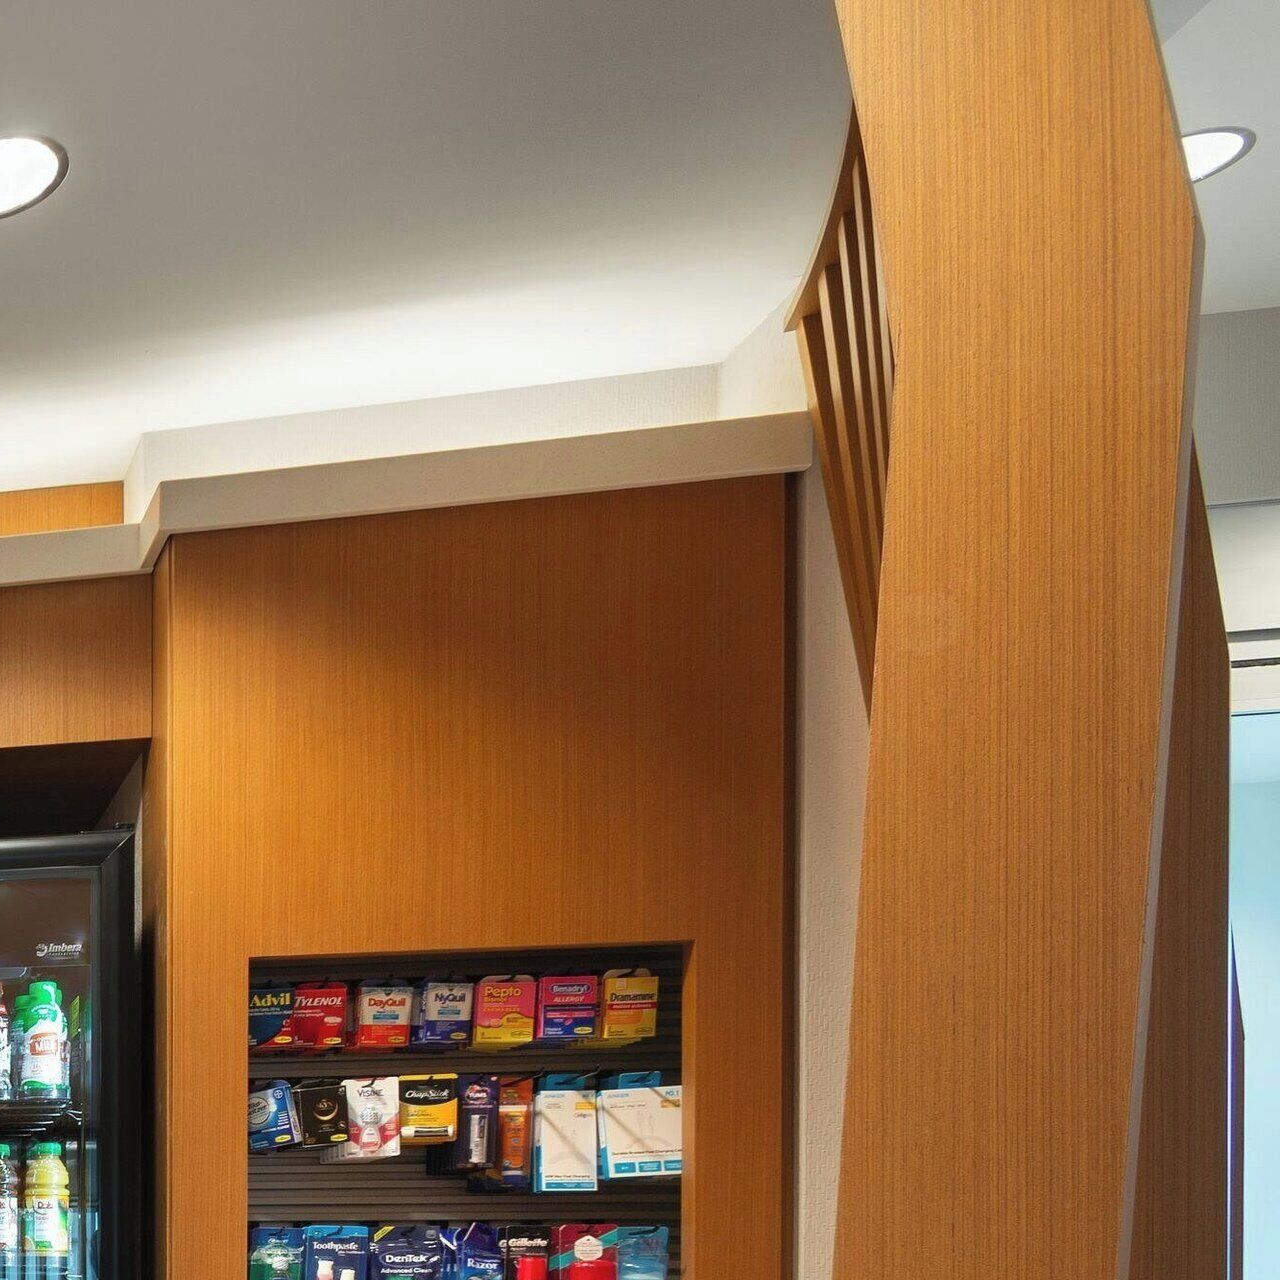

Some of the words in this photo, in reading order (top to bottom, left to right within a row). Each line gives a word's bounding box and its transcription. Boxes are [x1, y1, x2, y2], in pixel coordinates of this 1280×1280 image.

[48, 942, 83, 952] Imbera
[484, 985, 522, 998] Pepto
[552, 983, 588, 995] Benadryl
[249, 992, 290, 1007] Advil
[293, 995, 343, 1008] TYLENOL
[434, 991, 466, 1006] NyQuil
[553, 995, 584, 1003] ALLERGY
[610, 992, 655, 1002] Dramamine
[368, 997, 406, 1009] DayQuil
[404, 1088, 450, 1099] ChapStick
[312, 1241, 359, 1252] Toothpaste
[508, 1237, 548, 1248] Gillette
[385, 1253, 428, 1263] DenTek
[466, 1257, 498, 1270] Razor
